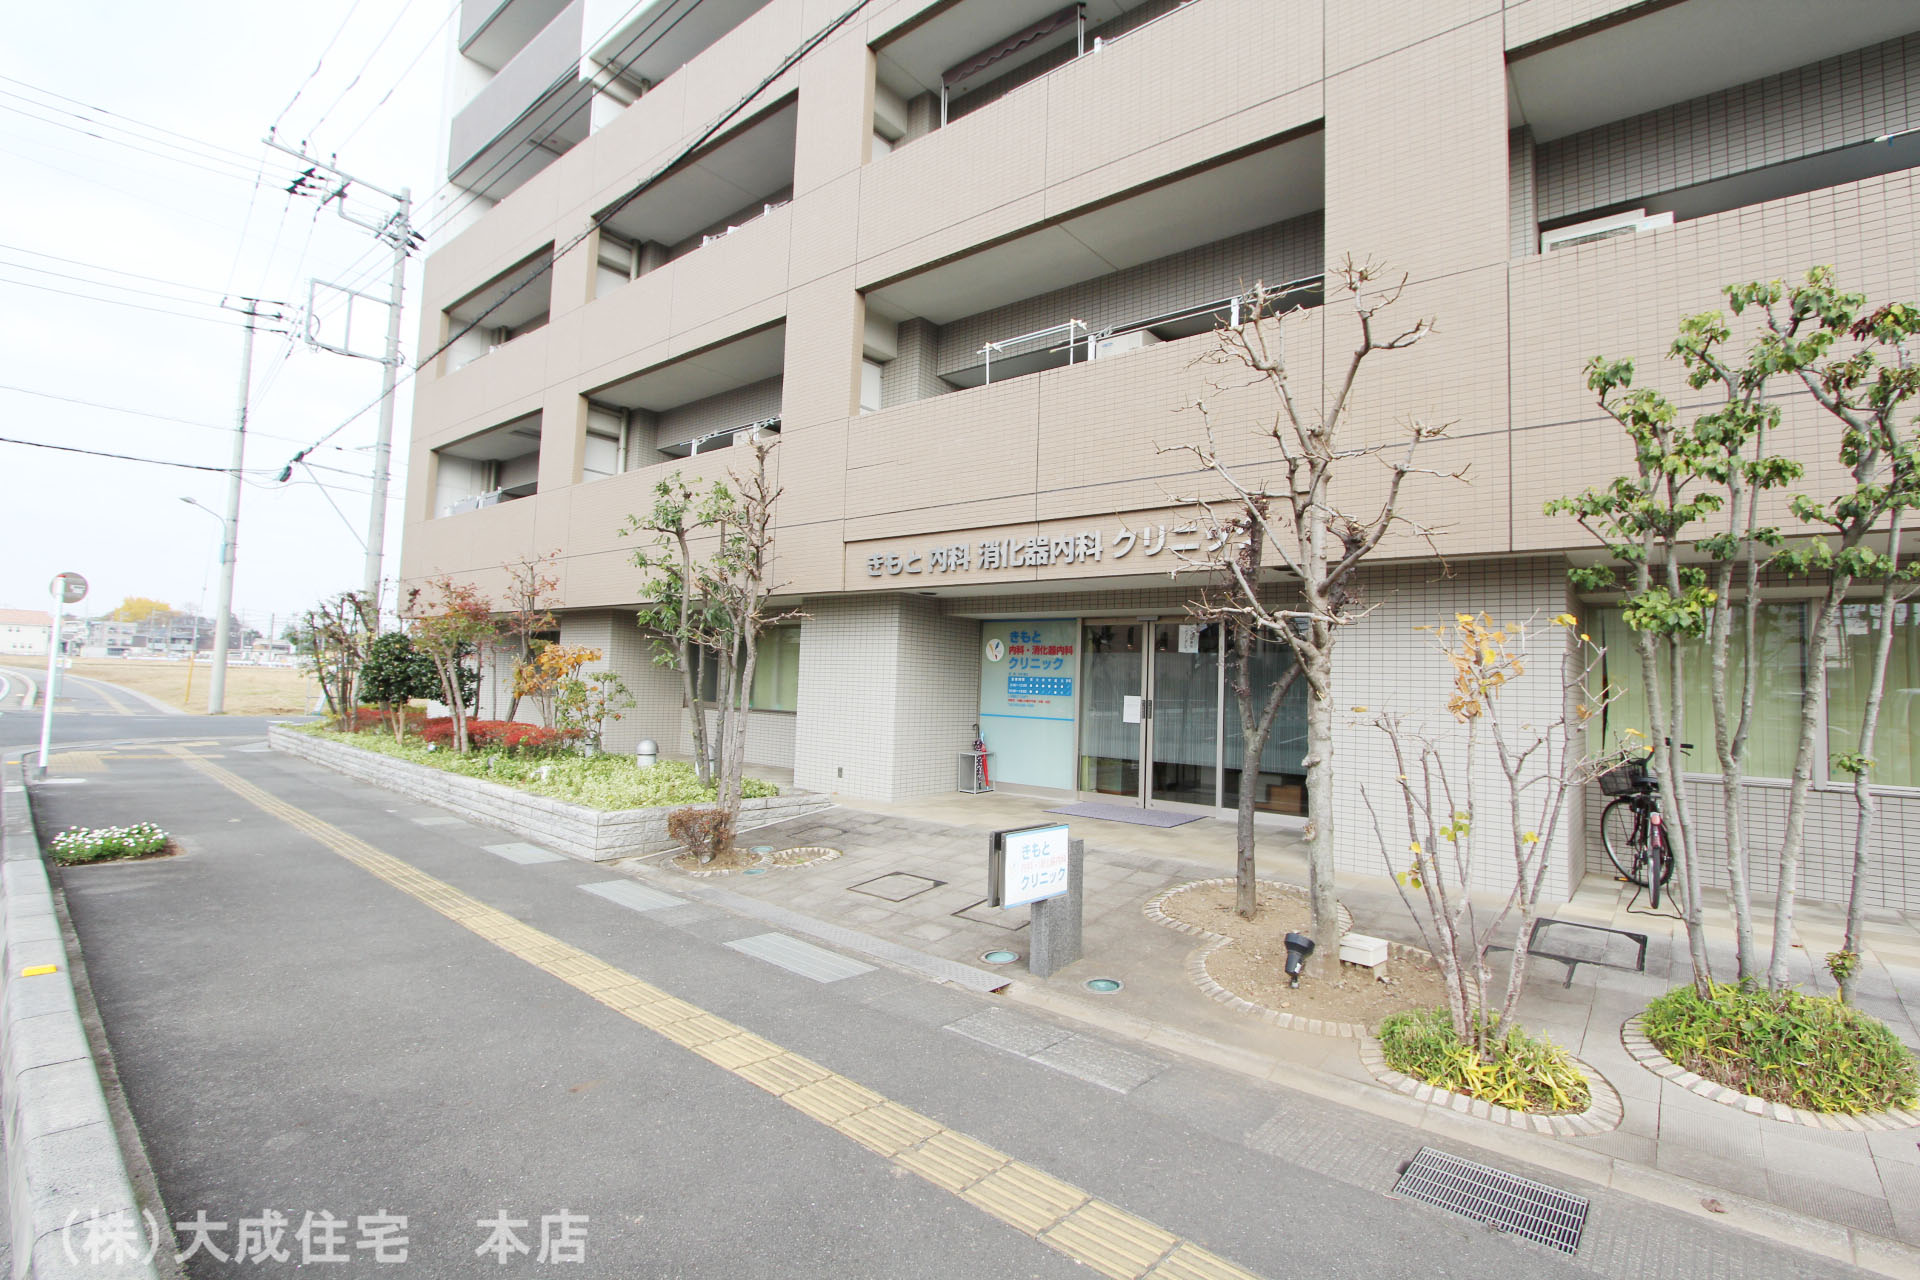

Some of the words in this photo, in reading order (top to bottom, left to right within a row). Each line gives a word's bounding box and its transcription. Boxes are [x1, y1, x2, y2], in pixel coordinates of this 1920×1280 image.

[868, 551, 922, 577] きもと
[928, 543, 971, 573] 内科
[978, 530, 1103, 570] 消化器内科
[1009, 631, 1041, 644] きもと
[1008, 656, 1064, 670] クリニック
[1022, 840, 1050, 860] きもと
[1021, 867, 1066, 891] クリニック
